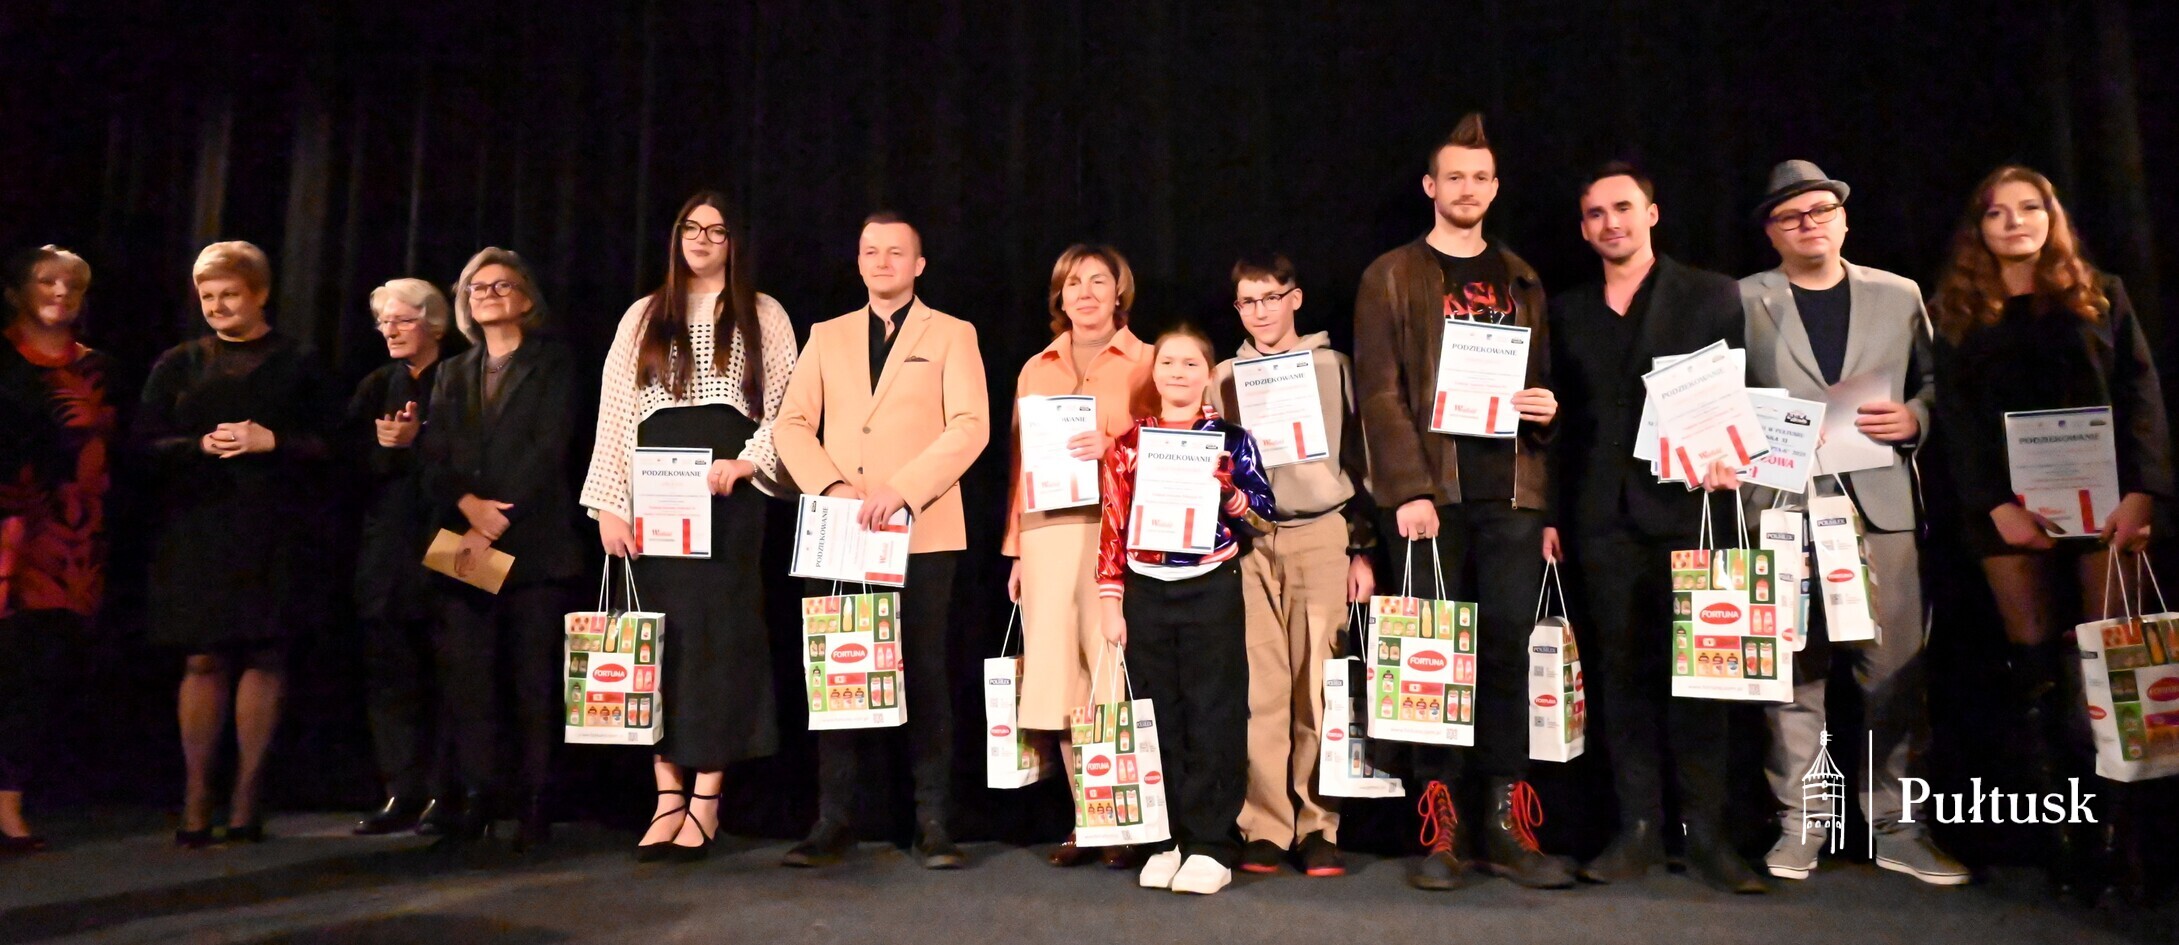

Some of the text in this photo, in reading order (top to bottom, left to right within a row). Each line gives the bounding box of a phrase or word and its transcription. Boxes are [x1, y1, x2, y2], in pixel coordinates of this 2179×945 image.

[1701, 610, 1739, 619] FORTUNA
[833, 649, 866, 658] FORTUNA
[1410, 656, 1444, 667] FORTUNA
[594, 669, 625, 678] FORTUNA
[1087, 762, 1110, 771] FORTUNA
